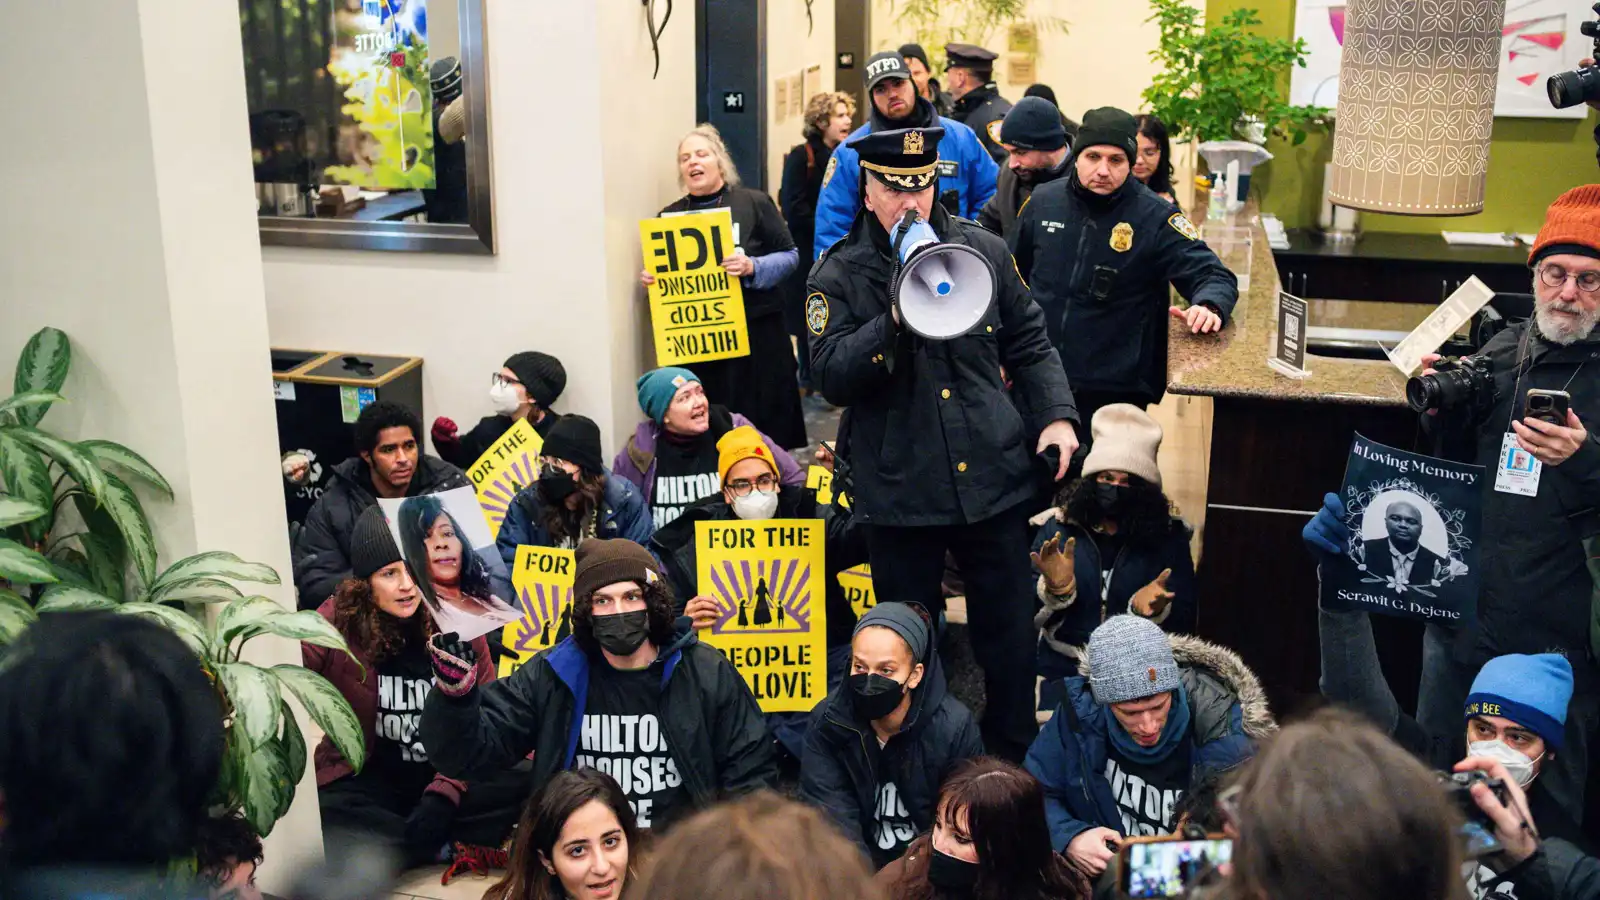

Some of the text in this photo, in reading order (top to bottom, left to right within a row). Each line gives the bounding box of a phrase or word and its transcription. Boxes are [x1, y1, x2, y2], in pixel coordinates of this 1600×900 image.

[866, 57, 901, 79] NYPD
[651, 225, 724, 274] ICE
[658, 271, 730, 297] HOUSING
[670, 302, 726, 324] STOP
[666, 329, 739, 357] HILTON:
[472, 429, 527, 484] OR THE
[1353, 441, 1478, 484] In Loving Memory
[709, 527, 810, 549] FOR THE
[525, 552, 570, 575] FOR
[1337, 589, 1461, 619] Serawit G. Dejene
[377, 674, 436, 711] HILTO
[753, 671, 812, 699] LOVE
[1482, 702, 1501, 716] BEE
